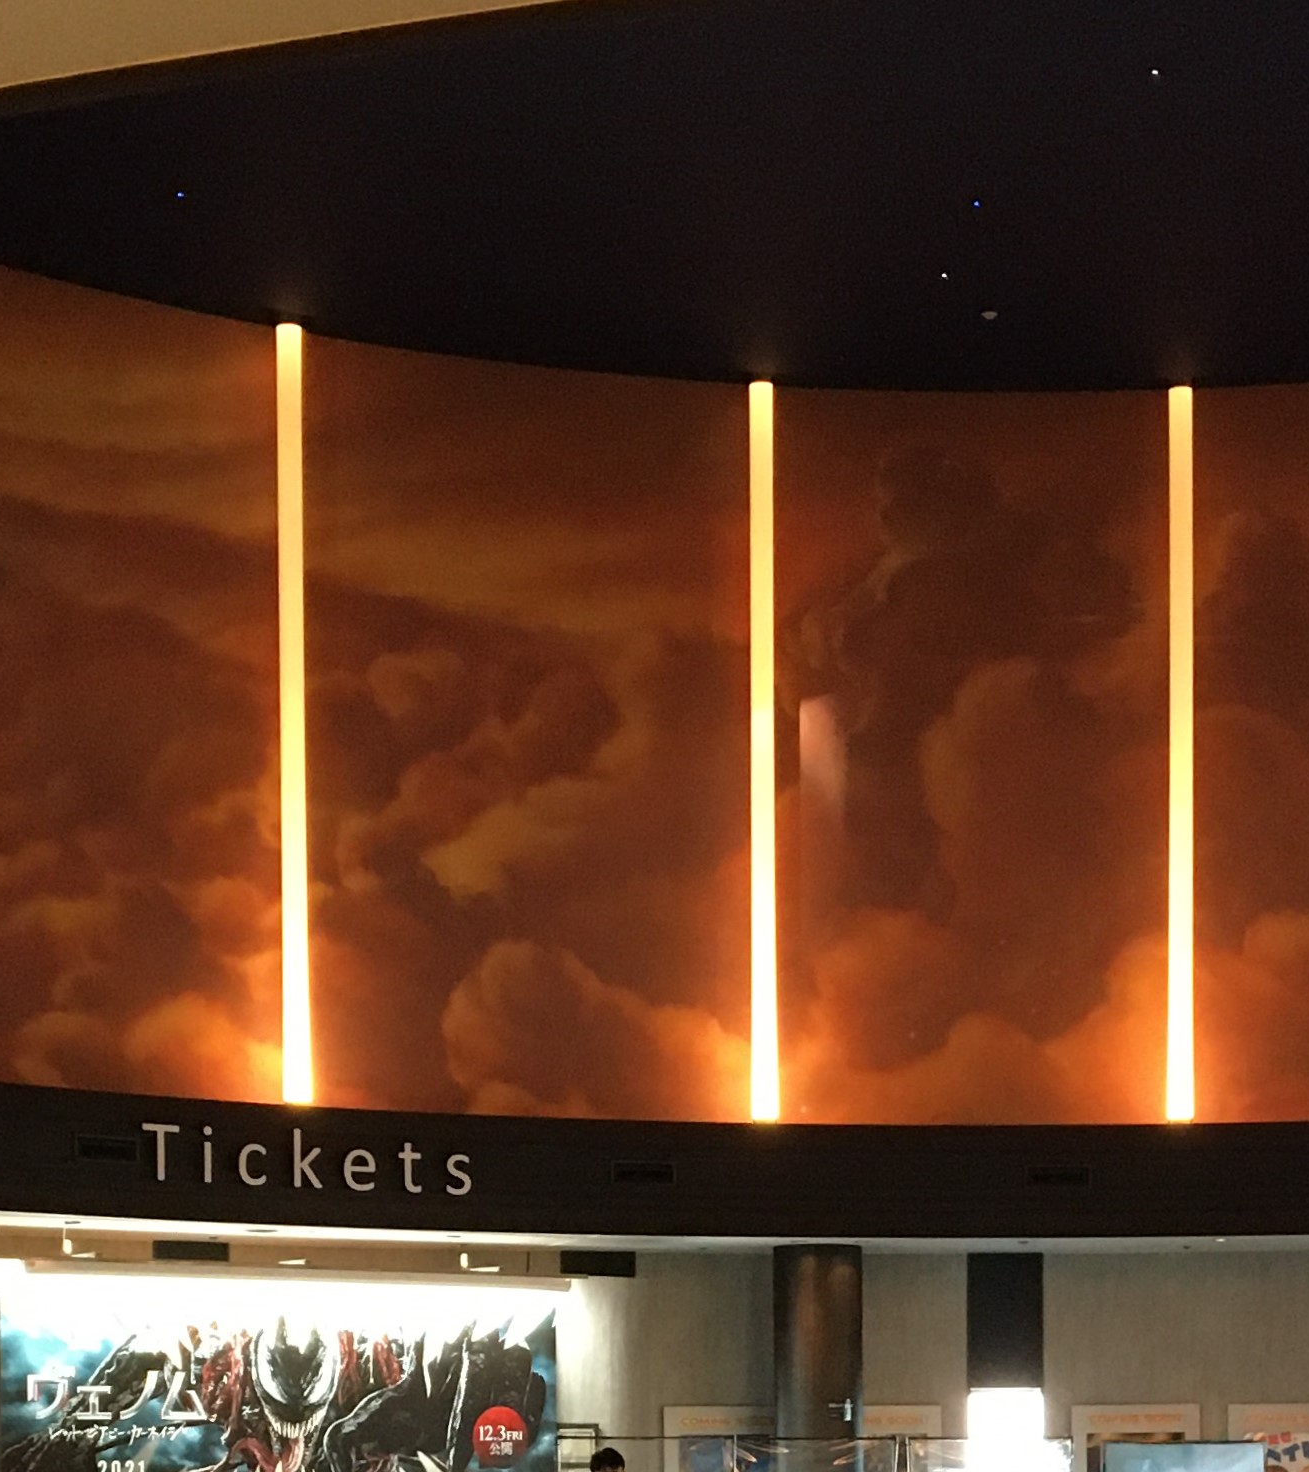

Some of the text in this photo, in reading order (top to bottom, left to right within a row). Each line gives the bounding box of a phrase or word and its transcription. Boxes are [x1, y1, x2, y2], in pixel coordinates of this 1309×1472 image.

[142, 1122, 473, 1196] Tickets
[26, 1366, 208, 1420] ヴェノム
[489, 1442, 513, 1455] 公開
